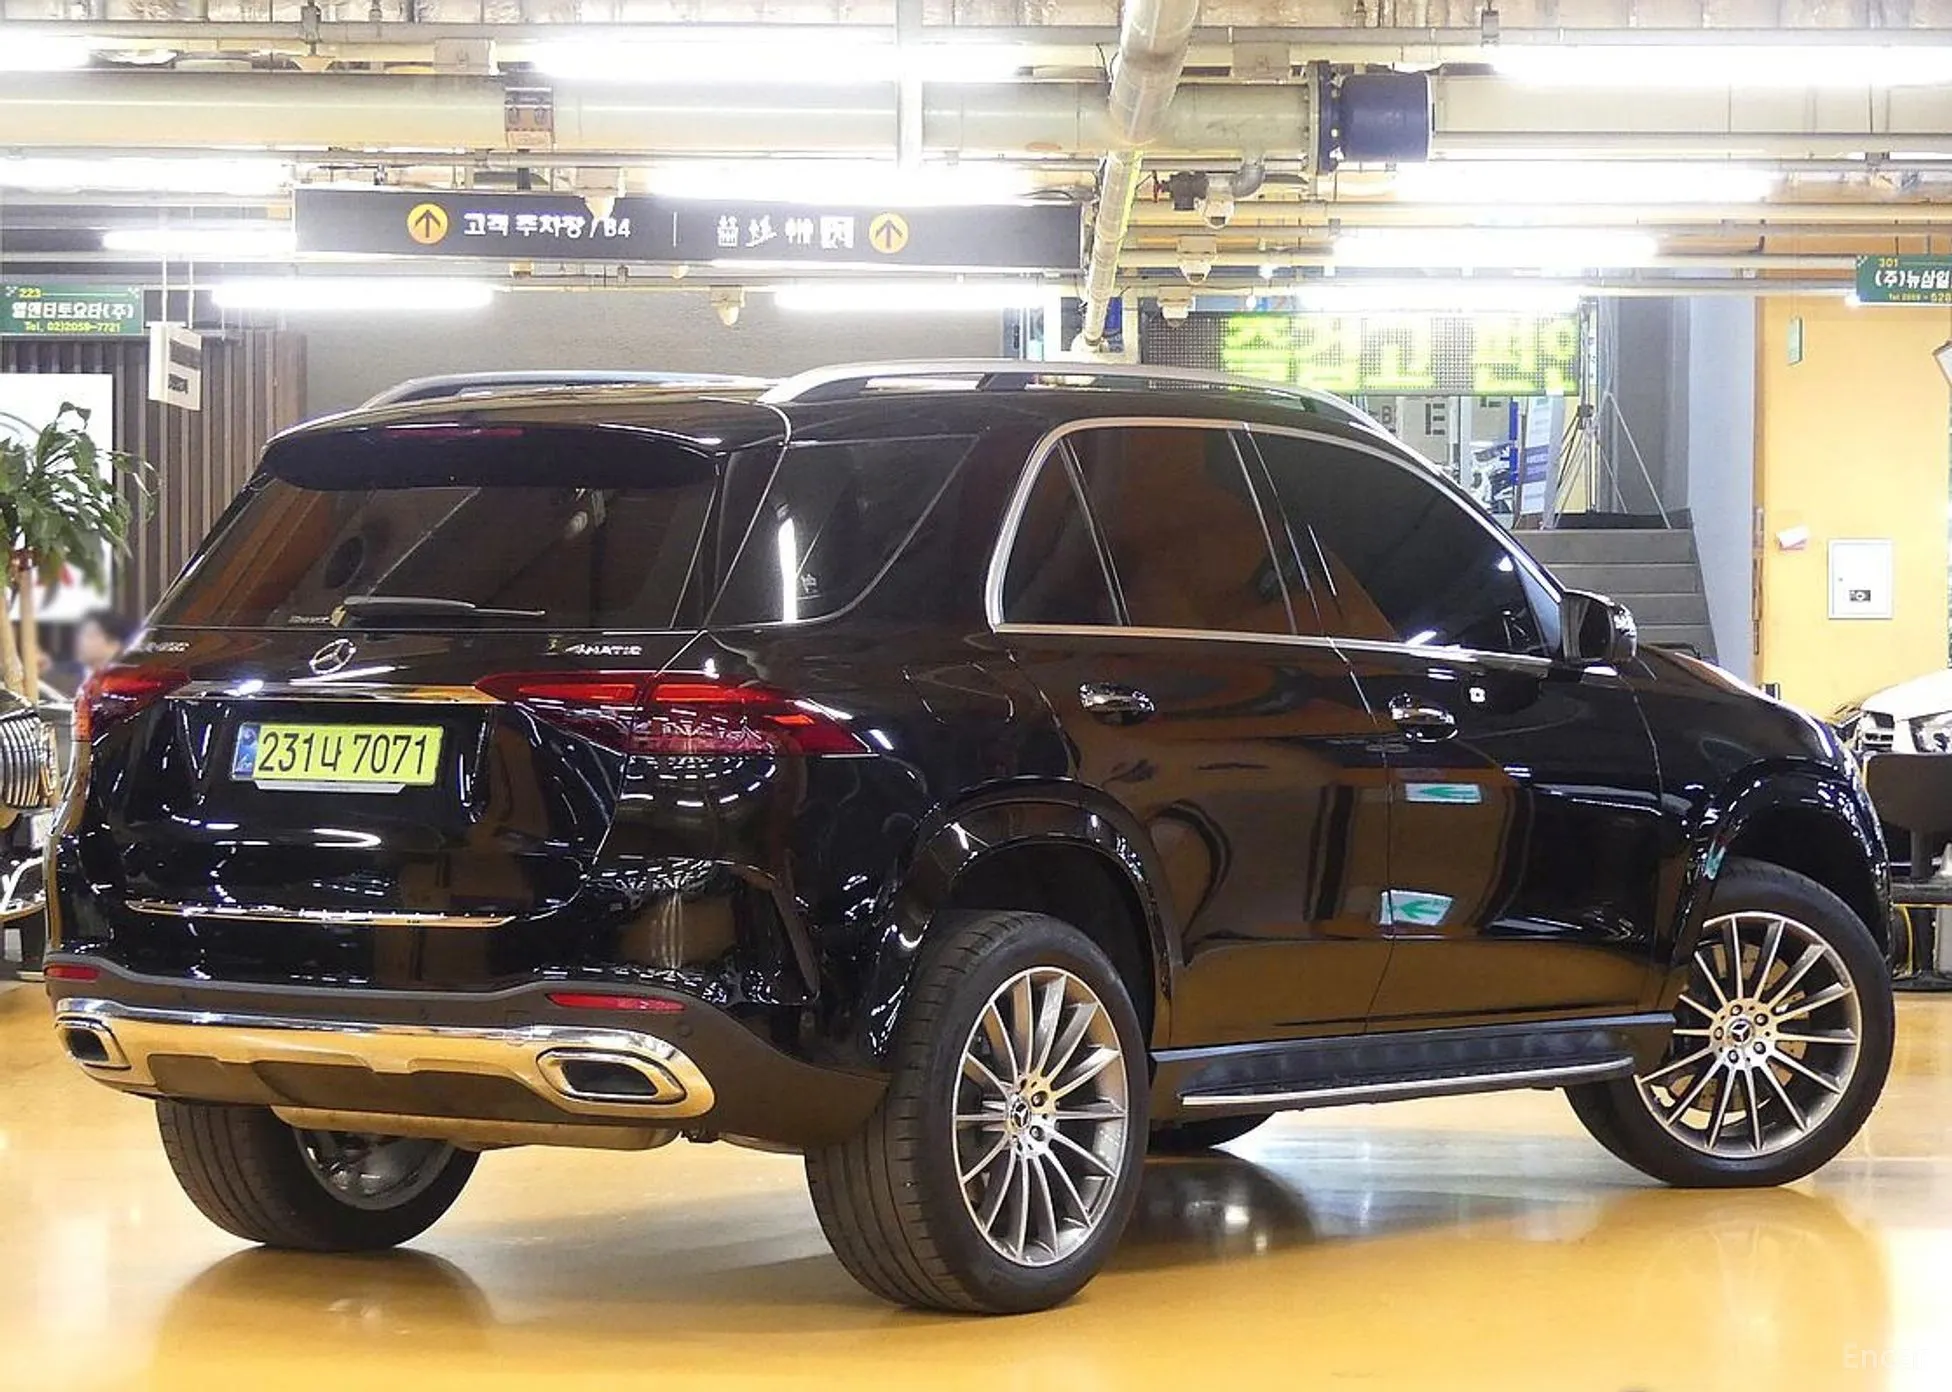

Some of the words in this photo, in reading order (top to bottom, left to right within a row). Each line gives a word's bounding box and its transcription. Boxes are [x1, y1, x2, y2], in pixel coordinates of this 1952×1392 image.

[463, 212, 509, 237] 고객
[515, 214, 586, 239] 주차장
[1879, 257, 1898, 268] 301
[19, 286, 42, 299] 223
[258, 731, 342, 773] 231나
[352, 733, 427, 775] 7071
